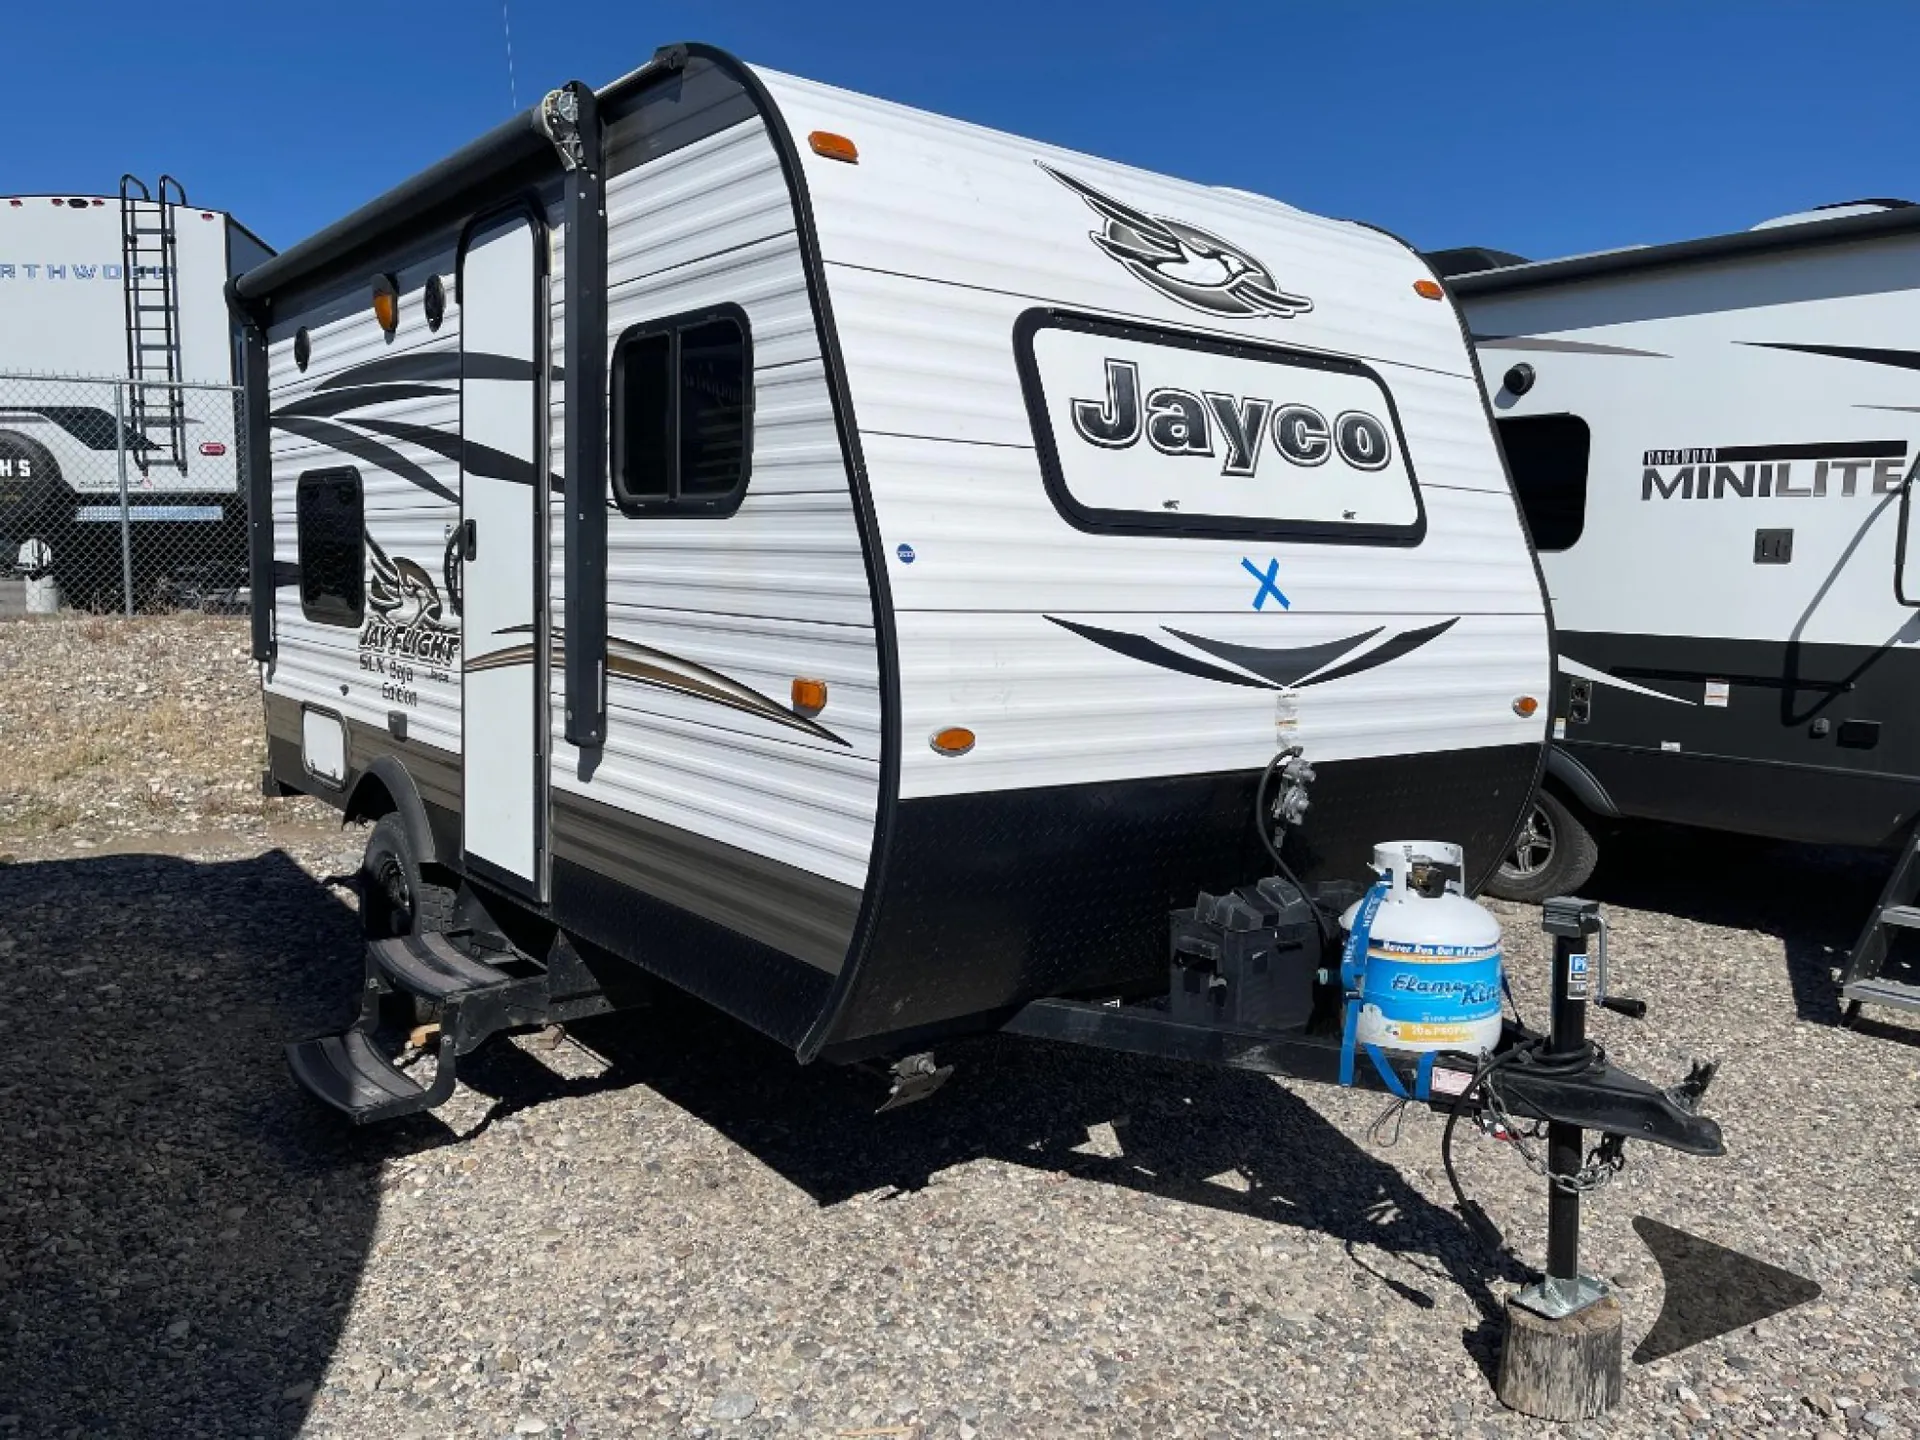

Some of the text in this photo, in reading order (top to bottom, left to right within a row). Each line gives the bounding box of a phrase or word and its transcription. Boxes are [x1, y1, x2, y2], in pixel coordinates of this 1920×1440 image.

[1070, 357, 1391, 478] Jayco
[1641, 459, 1906, 500] MINILITE
[360, 654, 385, 674] SLX
